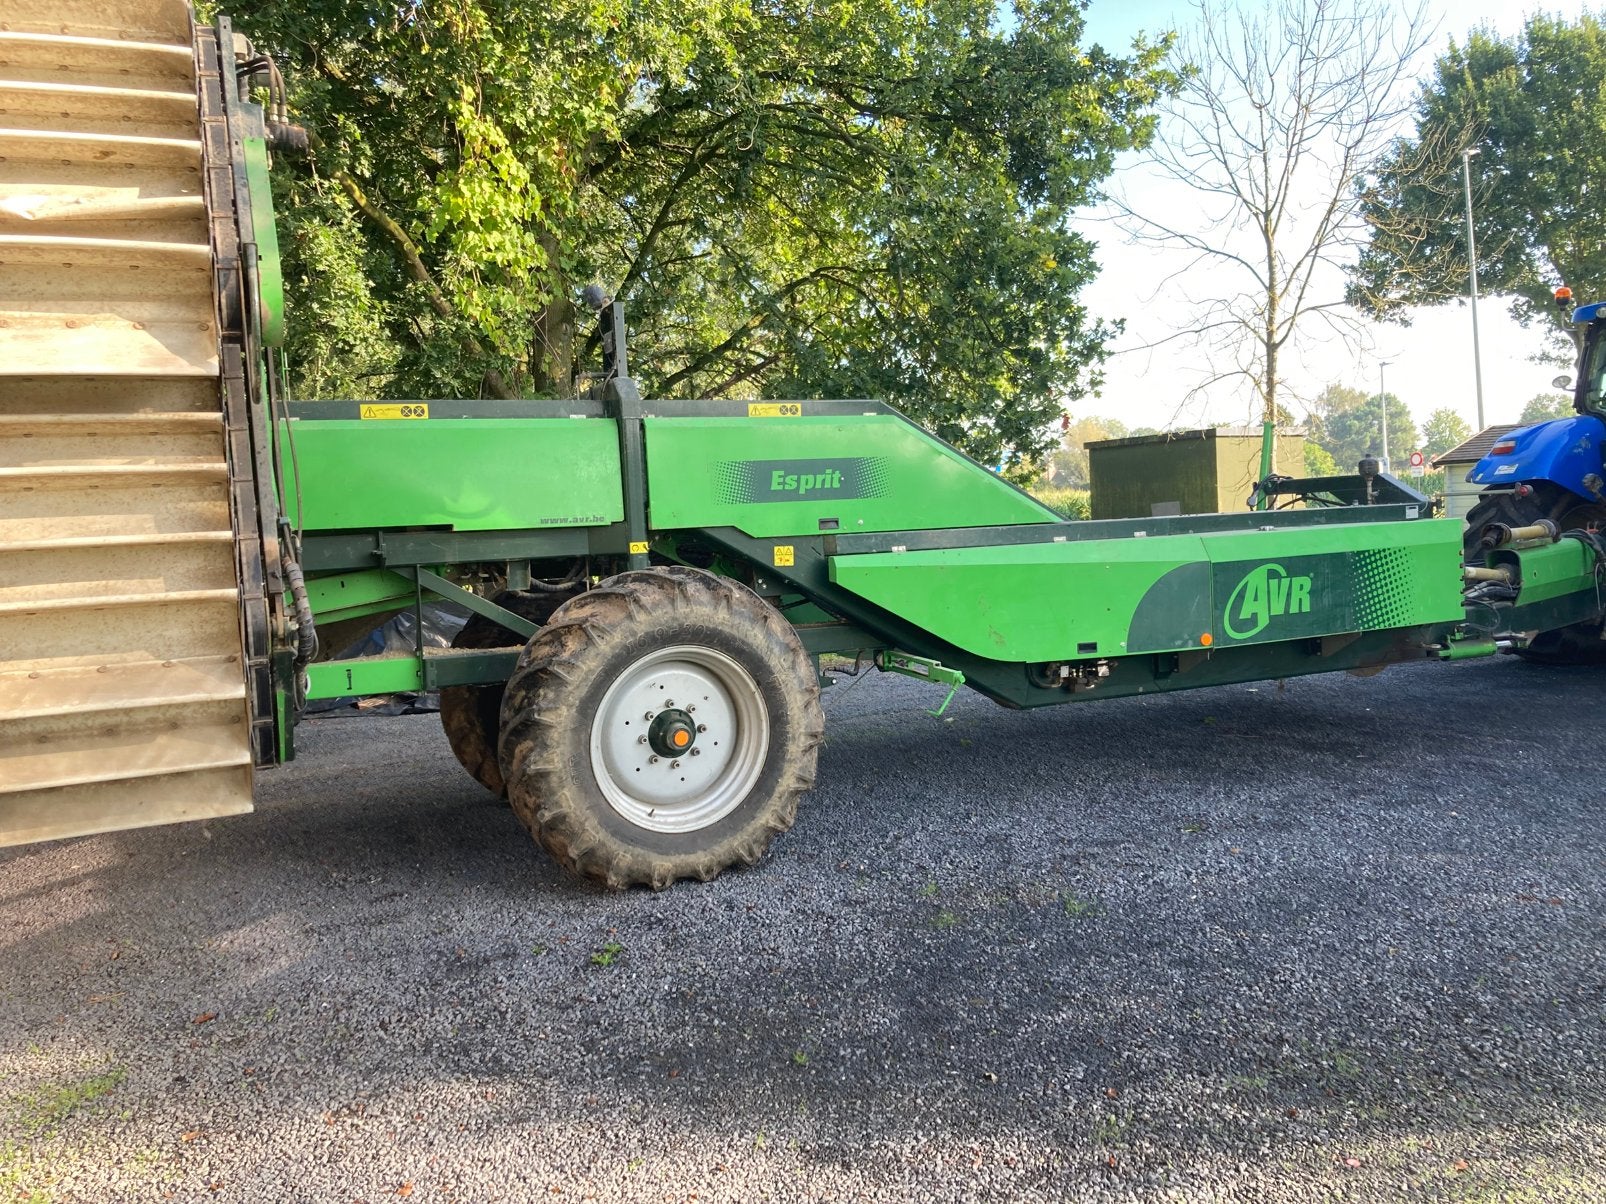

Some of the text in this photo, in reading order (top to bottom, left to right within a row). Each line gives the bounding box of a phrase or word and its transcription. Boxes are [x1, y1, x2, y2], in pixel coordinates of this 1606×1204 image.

[770, 468, 842, 495] Esprit
[540, 514, 605, 525] www.avr.be
[1224, 564, 1311, 639] AVR
